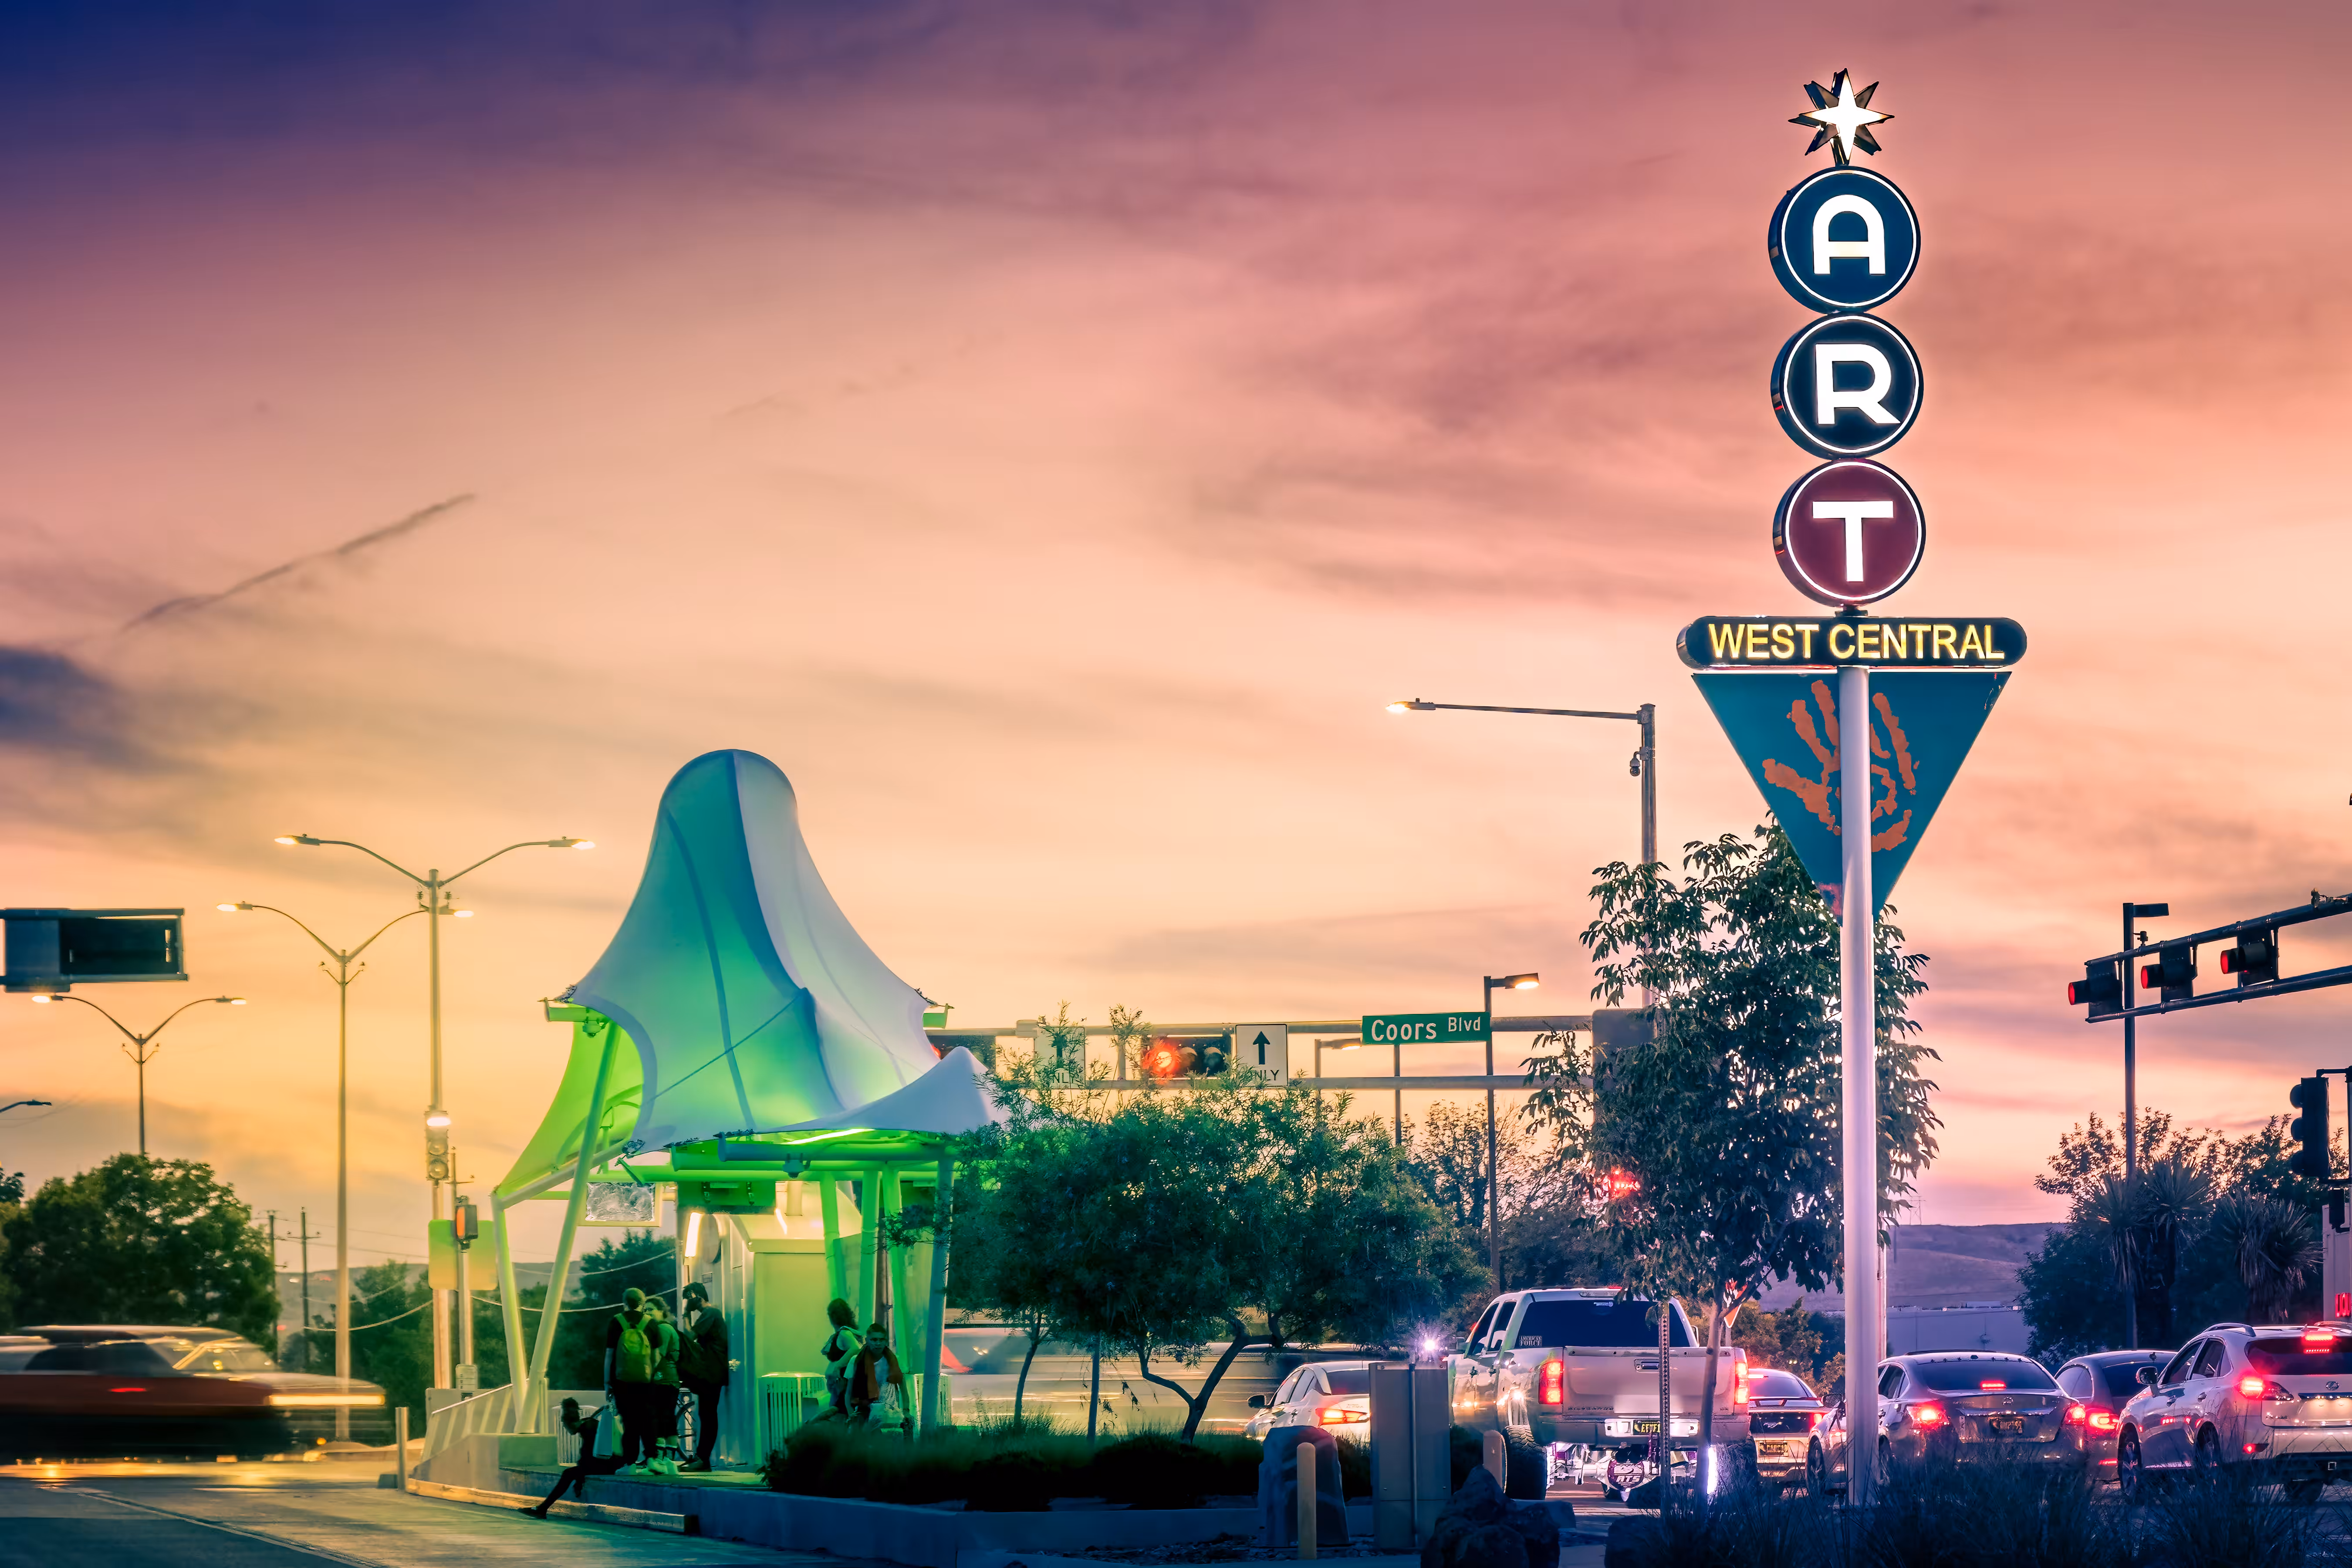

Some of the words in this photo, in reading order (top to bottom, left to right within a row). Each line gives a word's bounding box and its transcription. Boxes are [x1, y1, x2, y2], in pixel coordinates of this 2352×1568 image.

[1708, 623, 1819, 659] WEST
[1829, 624, 2005, 659] CENTRAL
[1372, 1020, 1437, 1041] Coors
[1448, 1016, 1480, 1032] Blvd
